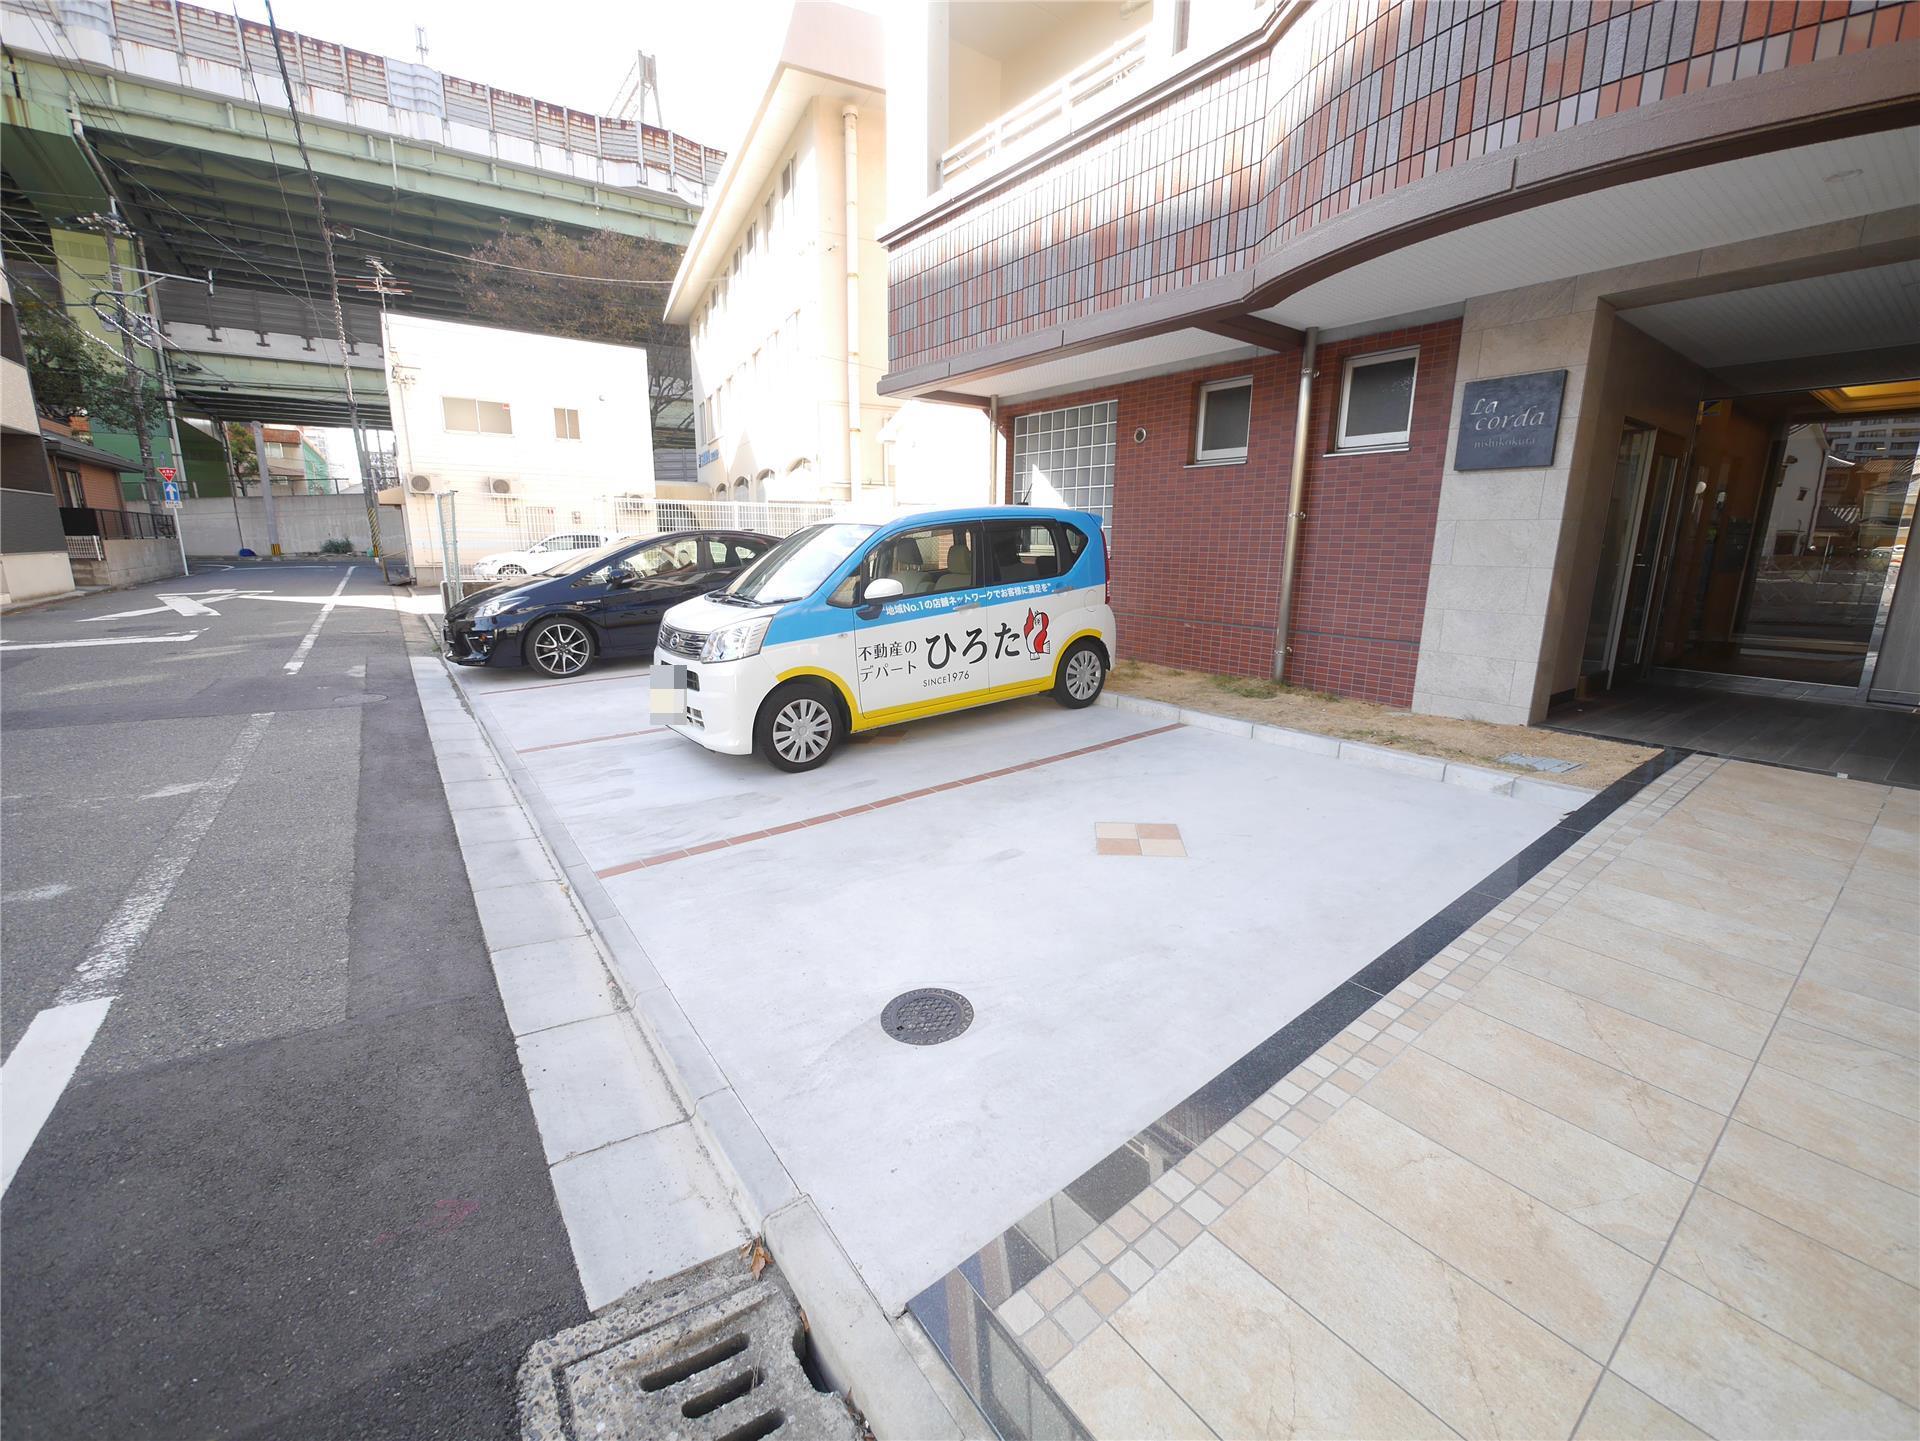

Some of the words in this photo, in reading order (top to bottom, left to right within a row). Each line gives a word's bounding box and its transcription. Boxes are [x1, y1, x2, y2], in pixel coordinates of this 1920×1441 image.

[1470, 398, 1498, 416] La
[1475, 405, 1545, 430] corda
[858, 640, 917, 662] 不動産の
[925, 622, 1020, 670] ひろた
[860, 660, 917, 682] デパート
